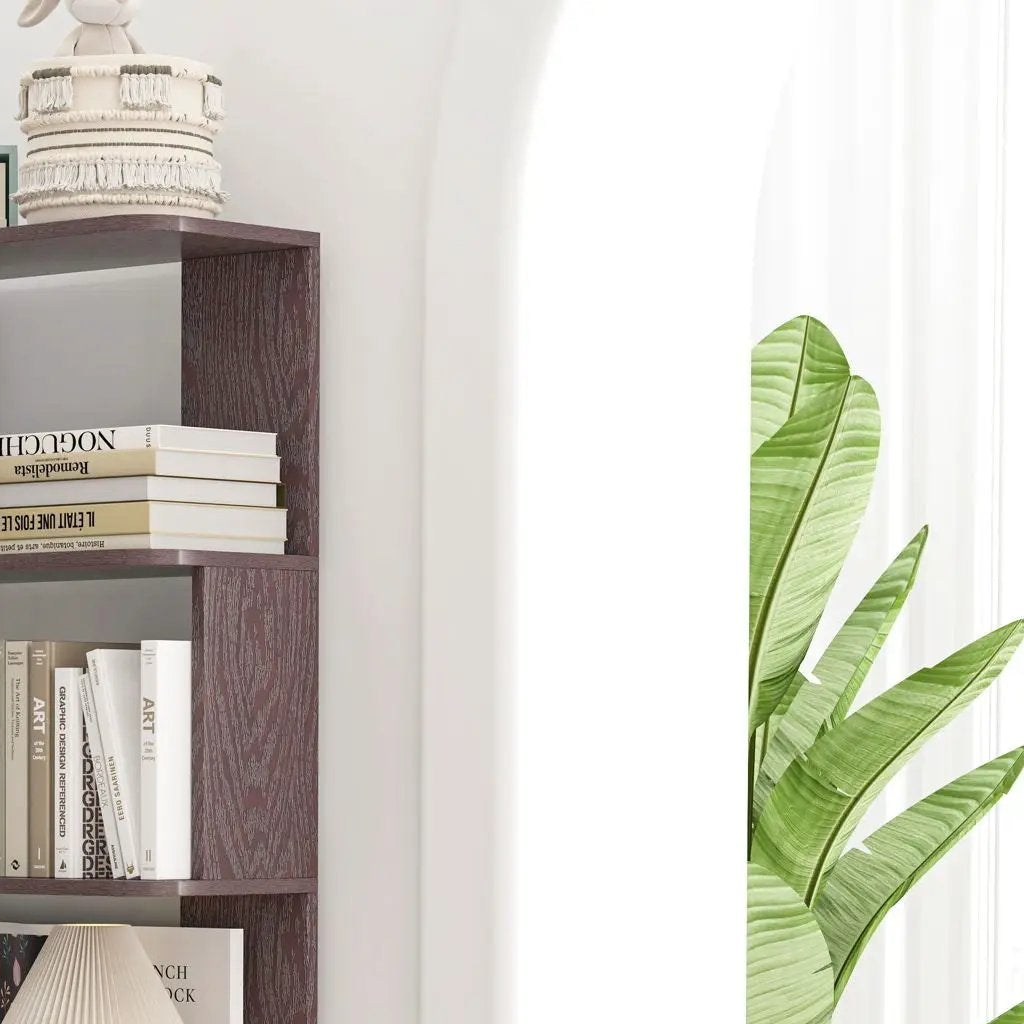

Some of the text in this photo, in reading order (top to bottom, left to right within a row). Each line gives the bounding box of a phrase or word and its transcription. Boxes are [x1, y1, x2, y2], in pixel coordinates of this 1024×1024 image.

[14, 461, 89, 478] Remodelista
[2, 515, 12, 531] LE
[15, 515, 36, 531] FOIS
[37, 513, 56, 529] UNE
[59, 512, 84, 531] ÉTAIT
[86, 511, 95, 527] IL
[33, 697, 46, 734] ART
[143, 697, 155, 734] ART
[108, 756, 125, 821] EERO SAARINEN
